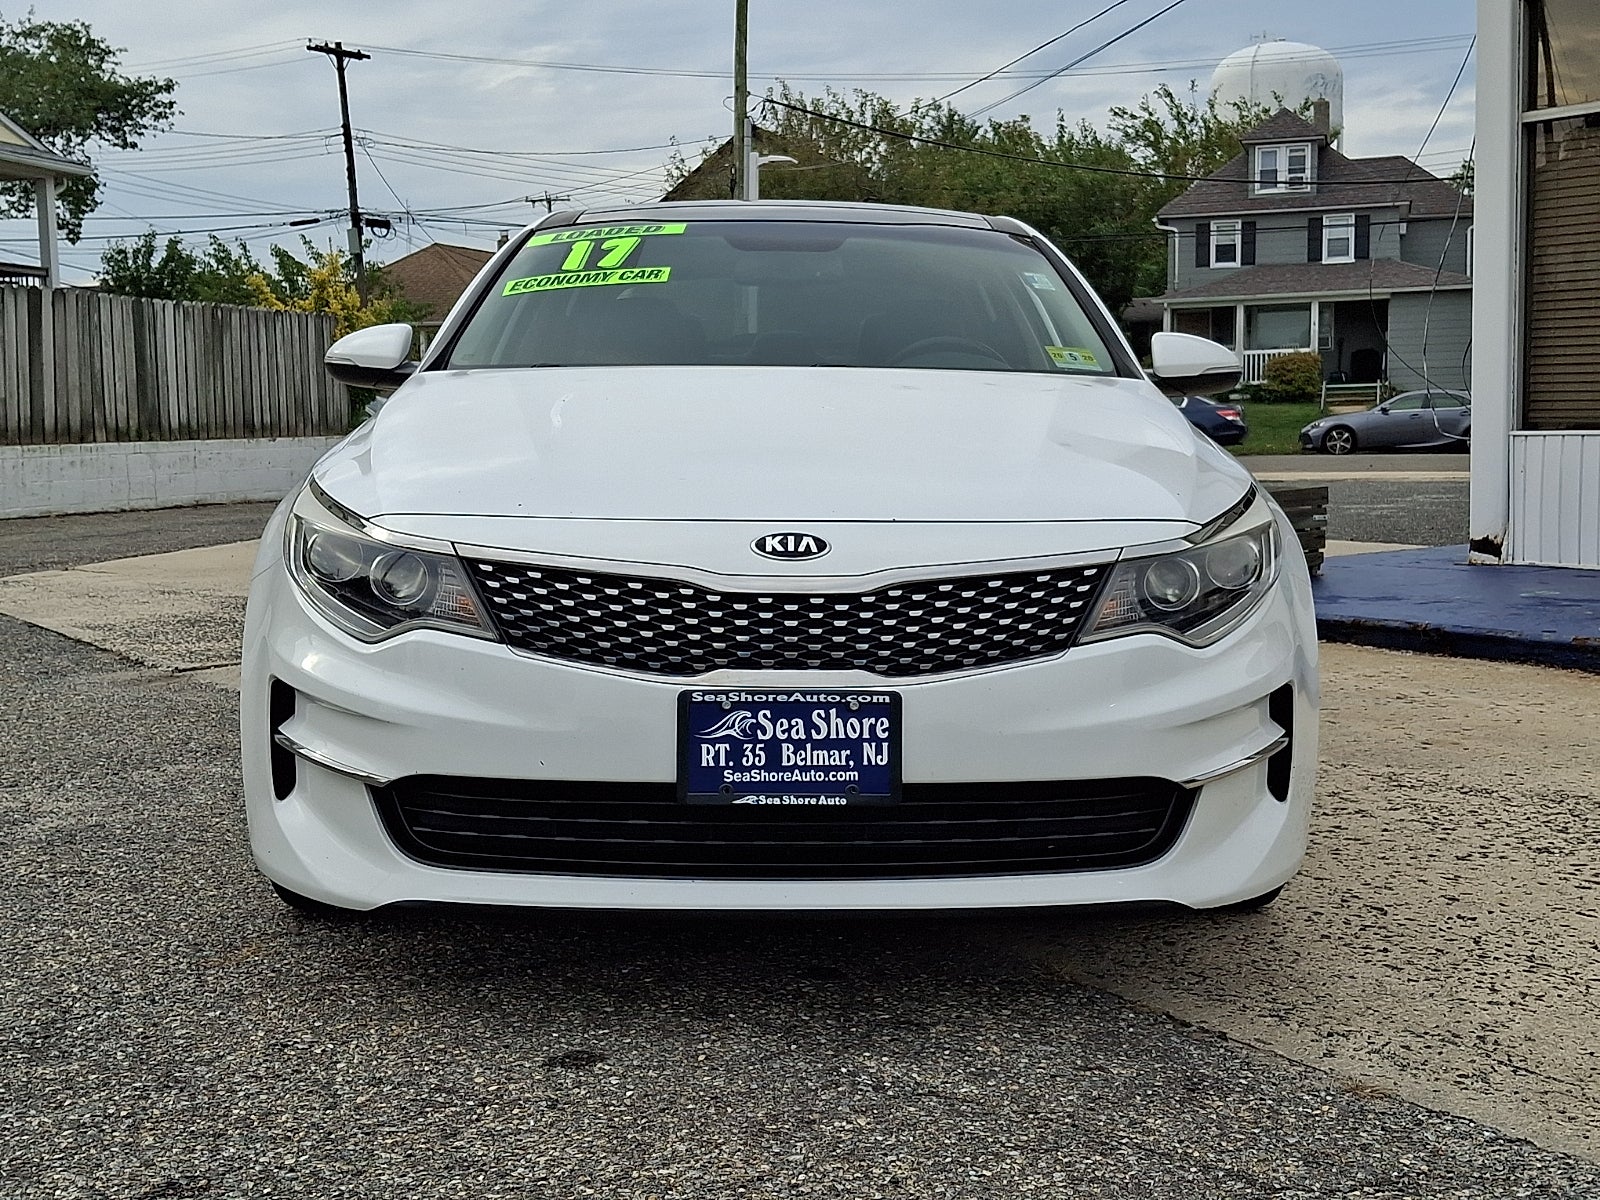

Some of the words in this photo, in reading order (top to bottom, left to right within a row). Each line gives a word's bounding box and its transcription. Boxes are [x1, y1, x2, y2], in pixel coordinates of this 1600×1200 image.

[551, 225, 666, 241] LOADED
[561, 236, 641, 271] 17
[509, 271, 616, 292] ECONOMY
[618, 269, 665, 281] CAR
[1068, 352, 1078, 361] 5
[765, 535, 819, 553] KIA
[691, 692, 891, 703] SeaShoreAuto.com
[757, 709, 807, 740] Sea
[811, 707, 890, 740] Shore
[700, 743, 734, 767] RT.
[742, 743, 766, 766] 35
[781, 742, 854, 768] Belmar,
[862, 742, 889, 766] NJ
[723, 769, 859, 782] SeaShoreAuto.com
[758, 795, 780, 805] Sea
[782, 795, 817, 805] Shore
[818, 795, 847, 805] Auto
